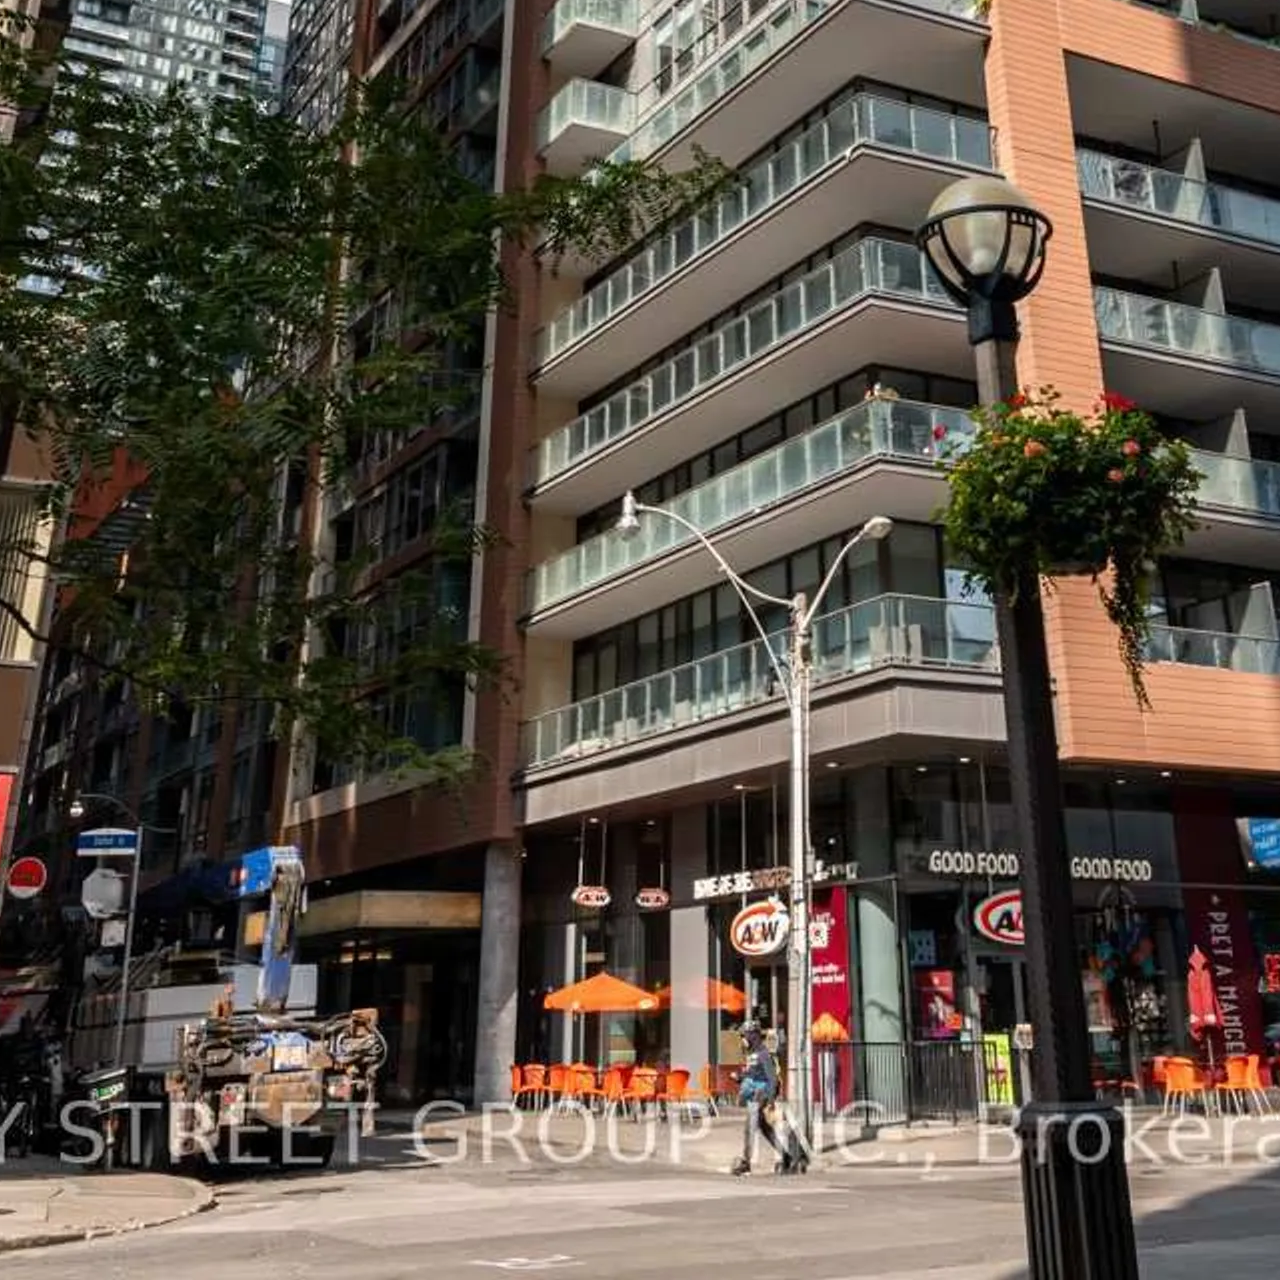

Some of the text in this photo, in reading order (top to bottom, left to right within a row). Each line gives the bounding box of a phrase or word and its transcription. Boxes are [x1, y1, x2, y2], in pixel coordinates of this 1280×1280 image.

[928, 850, 1151, 881] GOOD FOOD GOOD FOOD
[1207, 911, 1248, 1058] PRET A MANGE
